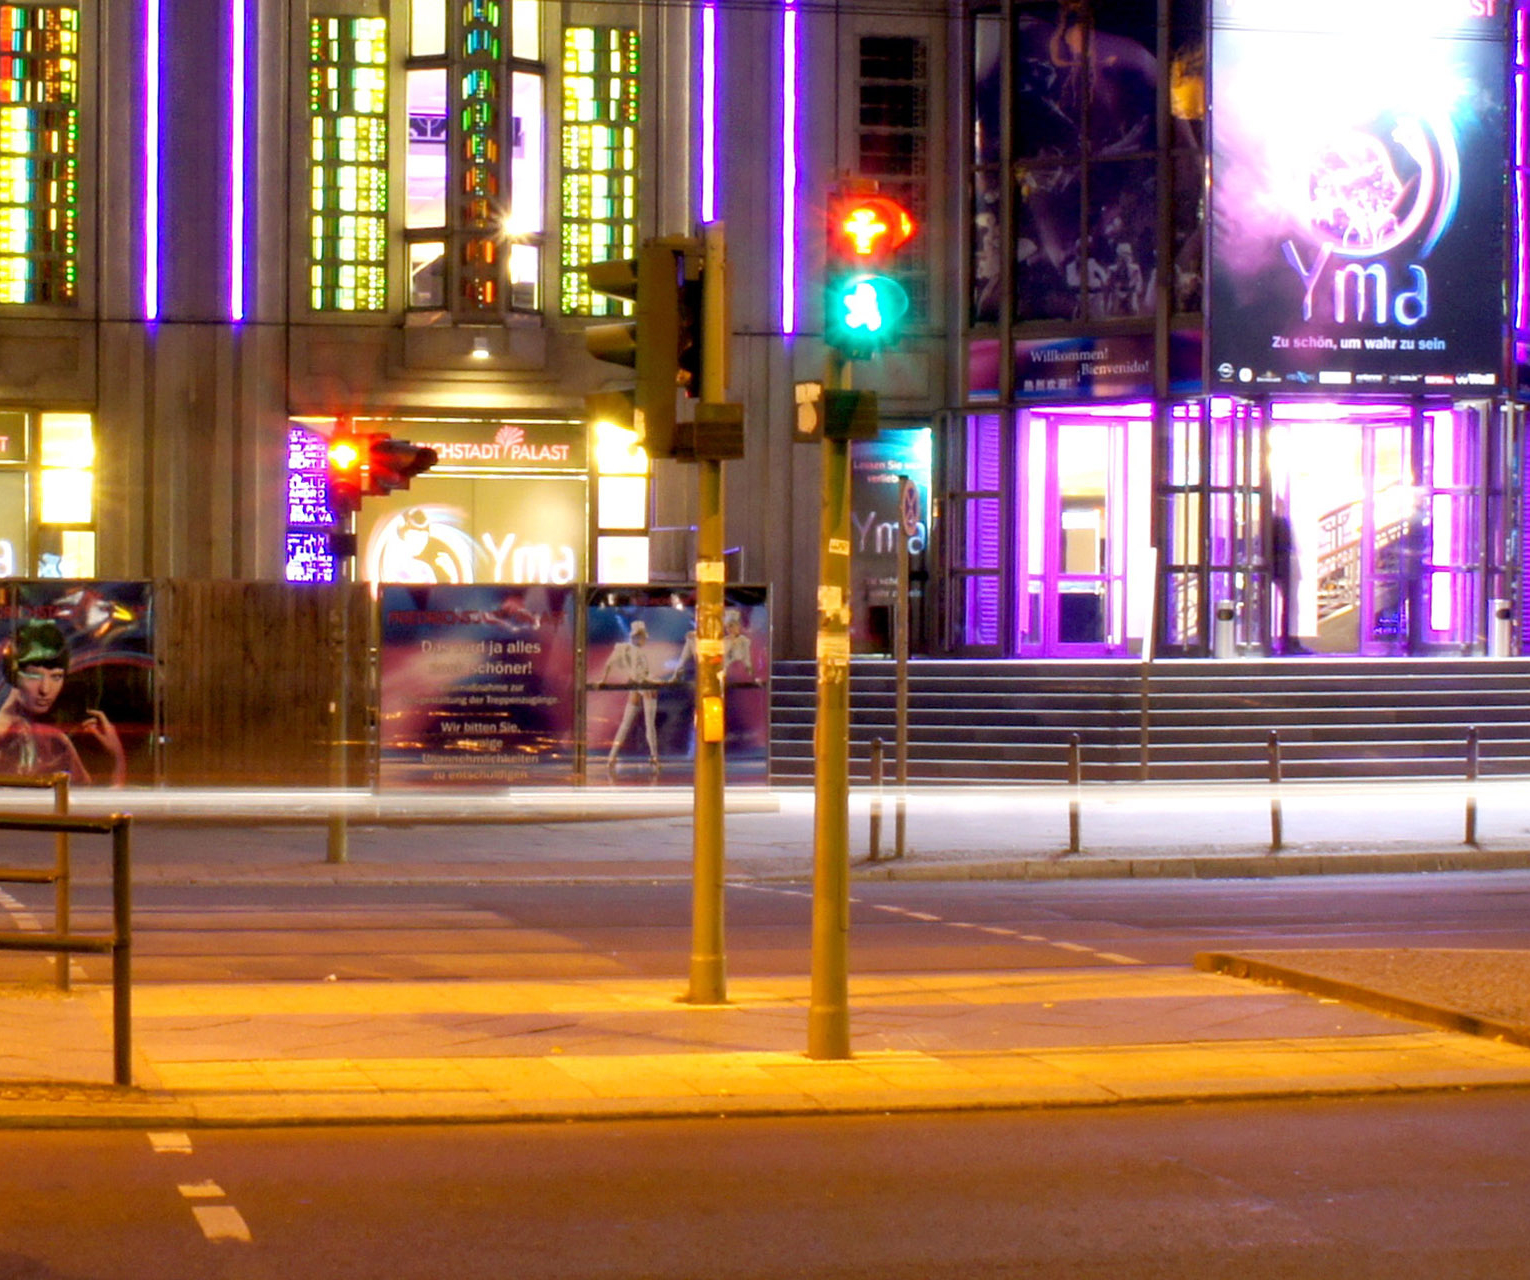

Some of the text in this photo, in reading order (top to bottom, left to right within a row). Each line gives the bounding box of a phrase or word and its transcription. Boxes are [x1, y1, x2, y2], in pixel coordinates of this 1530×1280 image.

[1281, 240, 1429, 326] Yma
[1272, 336, 1446, 350] Zu schön, um wahr zu sein
[1030, 348, 1109, 362] Willkommen!
[510, 445, 570, 461] PALAST
[481, 532, 575, 584] Yma
[489, 641, 503, 656] ja
[507, 640, 542, 654] alles
[473, 661, 533, 675] schöner!
[440, 722, 461, 733] Wir
[464, 722, 497, 733] bitten
